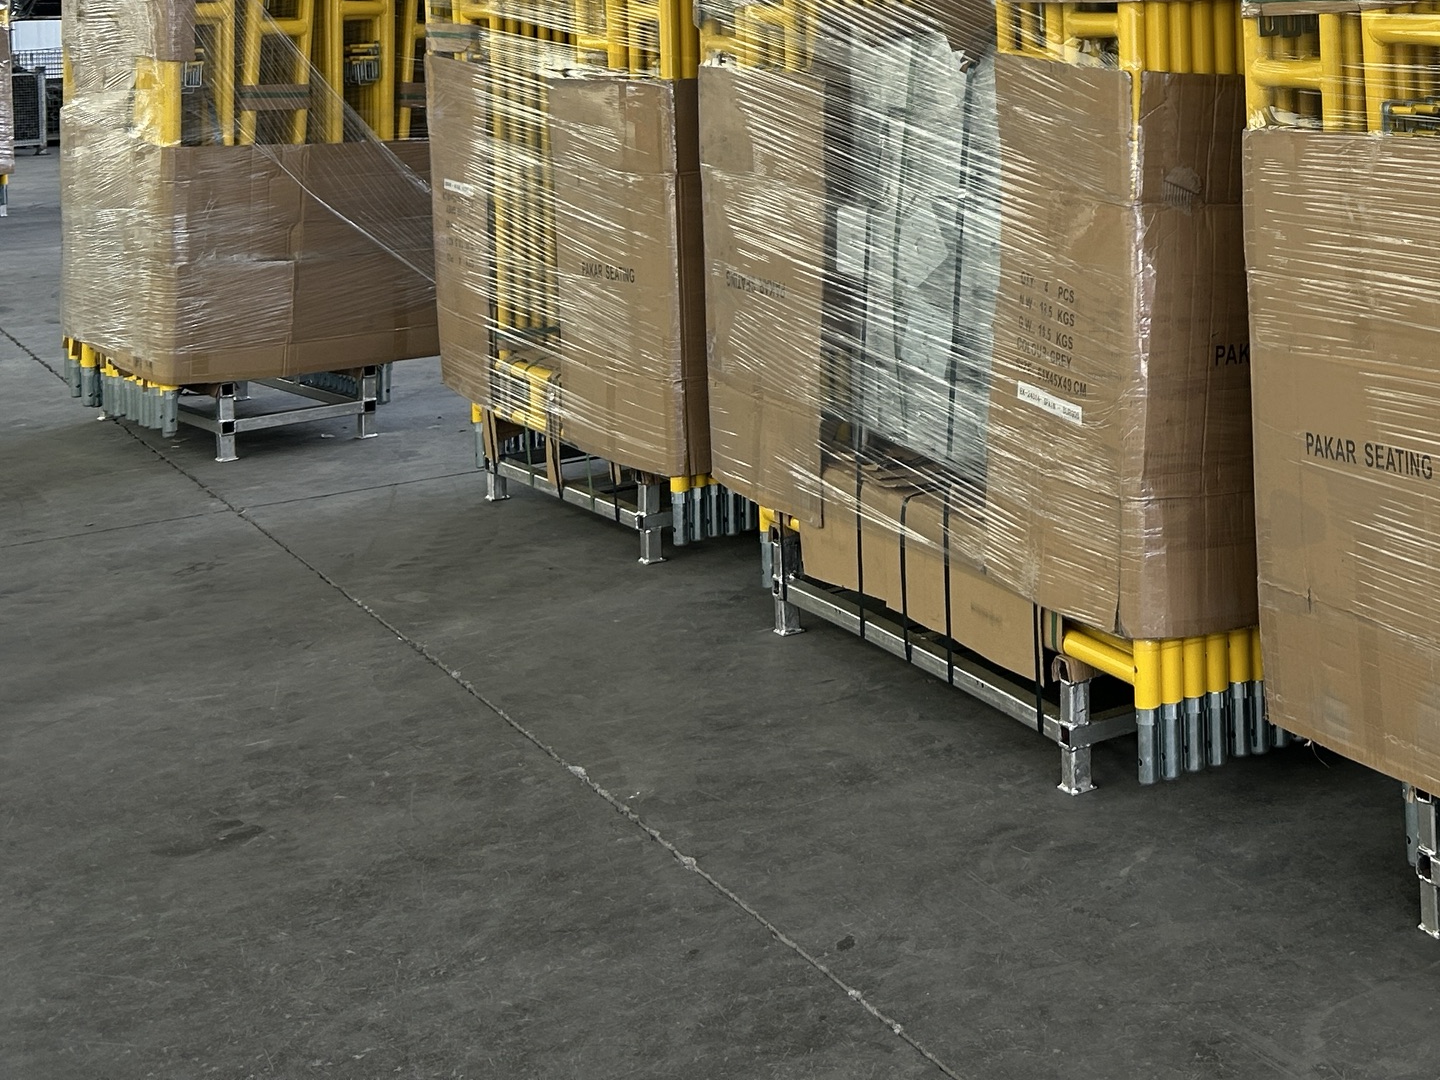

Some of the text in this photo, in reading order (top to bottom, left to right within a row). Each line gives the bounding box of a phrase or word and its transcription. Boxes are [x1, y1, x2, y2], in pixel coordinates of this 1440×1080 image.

[1057, 286, 1075, 304] PCS
[1057, 309, 1075, 327] KGS
[1056, 332, 1074, 350] KGS
[1049, 350, 1072, 369] GREY
[1073, 381, 1087, 398] CM
[1305, 432, 1433, 480] PAKAR SEATING
